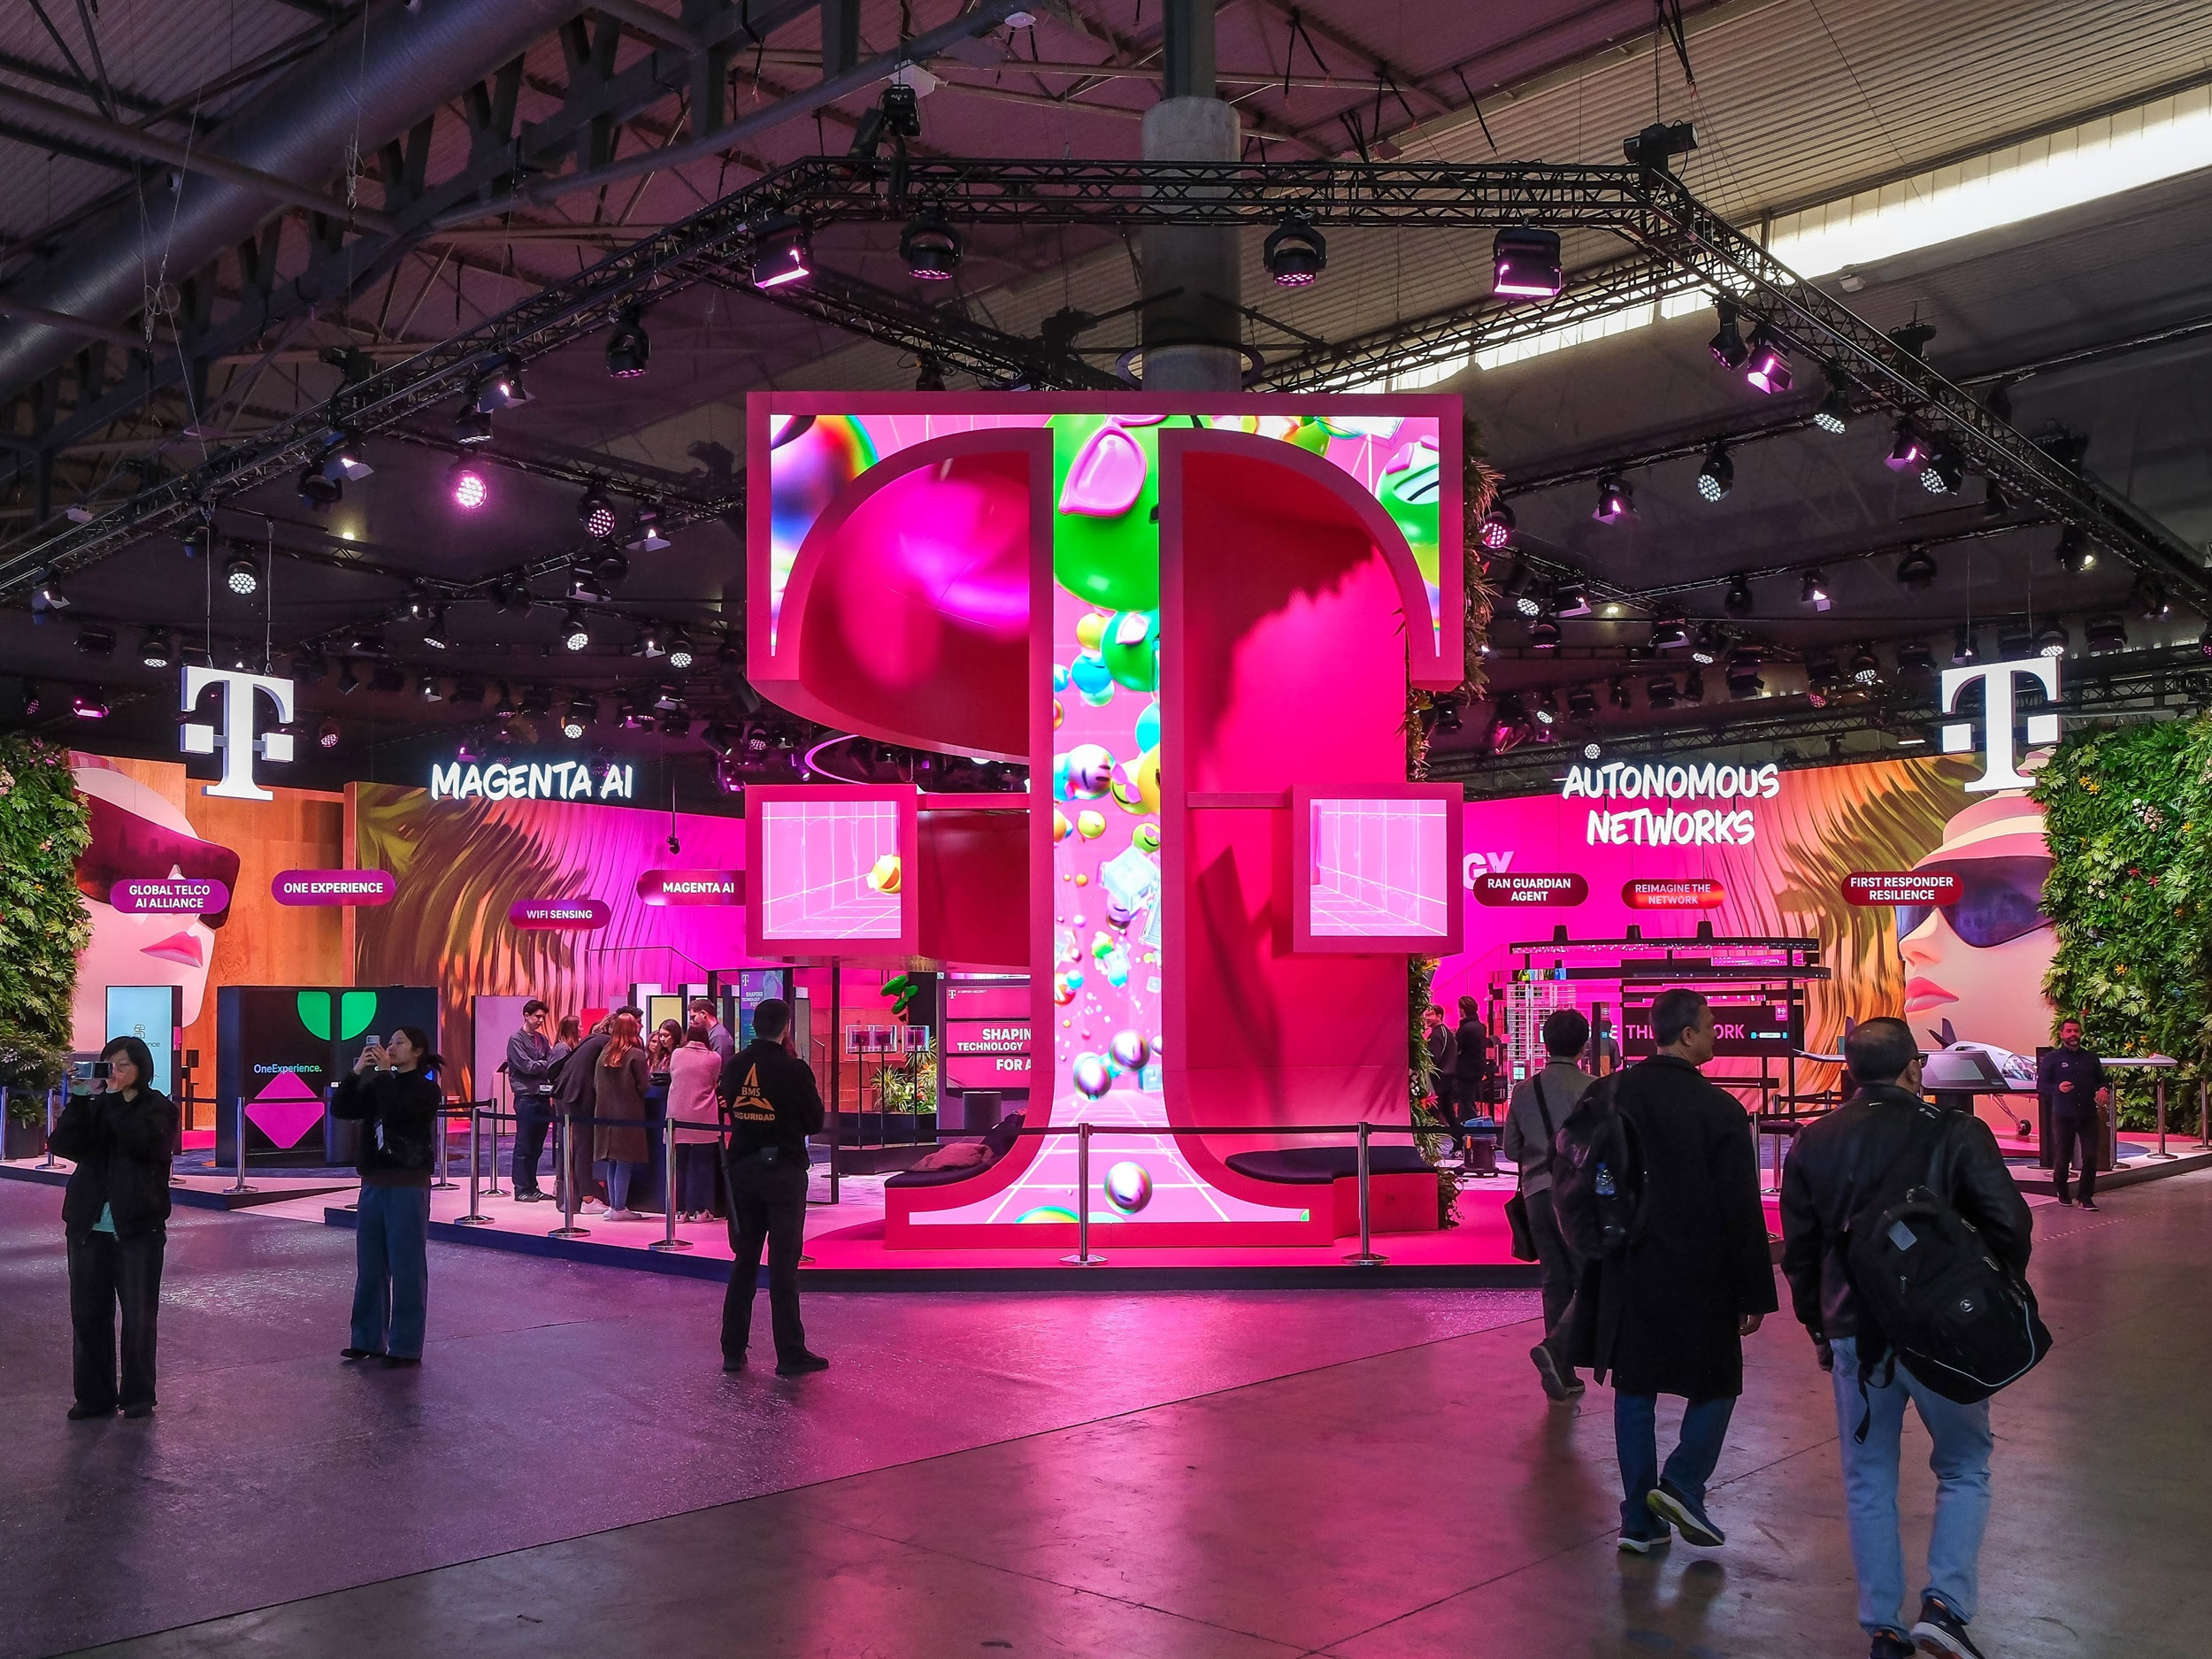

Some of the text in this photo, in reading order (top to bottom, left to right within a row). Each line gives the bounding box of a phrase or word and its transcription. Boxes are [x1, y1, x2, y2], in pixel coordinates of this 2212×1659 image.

[1941, 656, 2062, 793] T
[180, 665, 294, 801] T
[431, 761, 633, 801] MAGENTA AI
[1562, 762, 1780, 800] AUTONOMOUS
[1586, 807, 1755, 847] NETWORKS
[1487, 878, 1571, 888] RAN GUARDIAN
[1850, 877, 1954, 887] FIRST RESPONDER
[129, 885, 210, 895] GLOBAL TELCO
[283, 883, 383, 893] ONE EXPERIENCE
[663, 882, 734, 893] MAGENTA AI
[1635, 884, 1710, 893] REIMAGINE THE
[1510, 891, 1548, 901] AGENT
[1648, 895, 1698, 904] NETWORK
[1870, 890, 1935, 900] RESILIENCE
[135, 898, 204, 908] AI ALLIANCE
[526, 910, 593, 918] WIFI SENSING
[982, 1028, 1031, 1041] SHAPIN
[957, 1042, 1023, 1051] TECHNOLOGY
[254, 1064, 322, 1074] OneExperience.
[996, 1059, 1023, 1071] FOR
[741, 1087, 761, 1097] BMS
